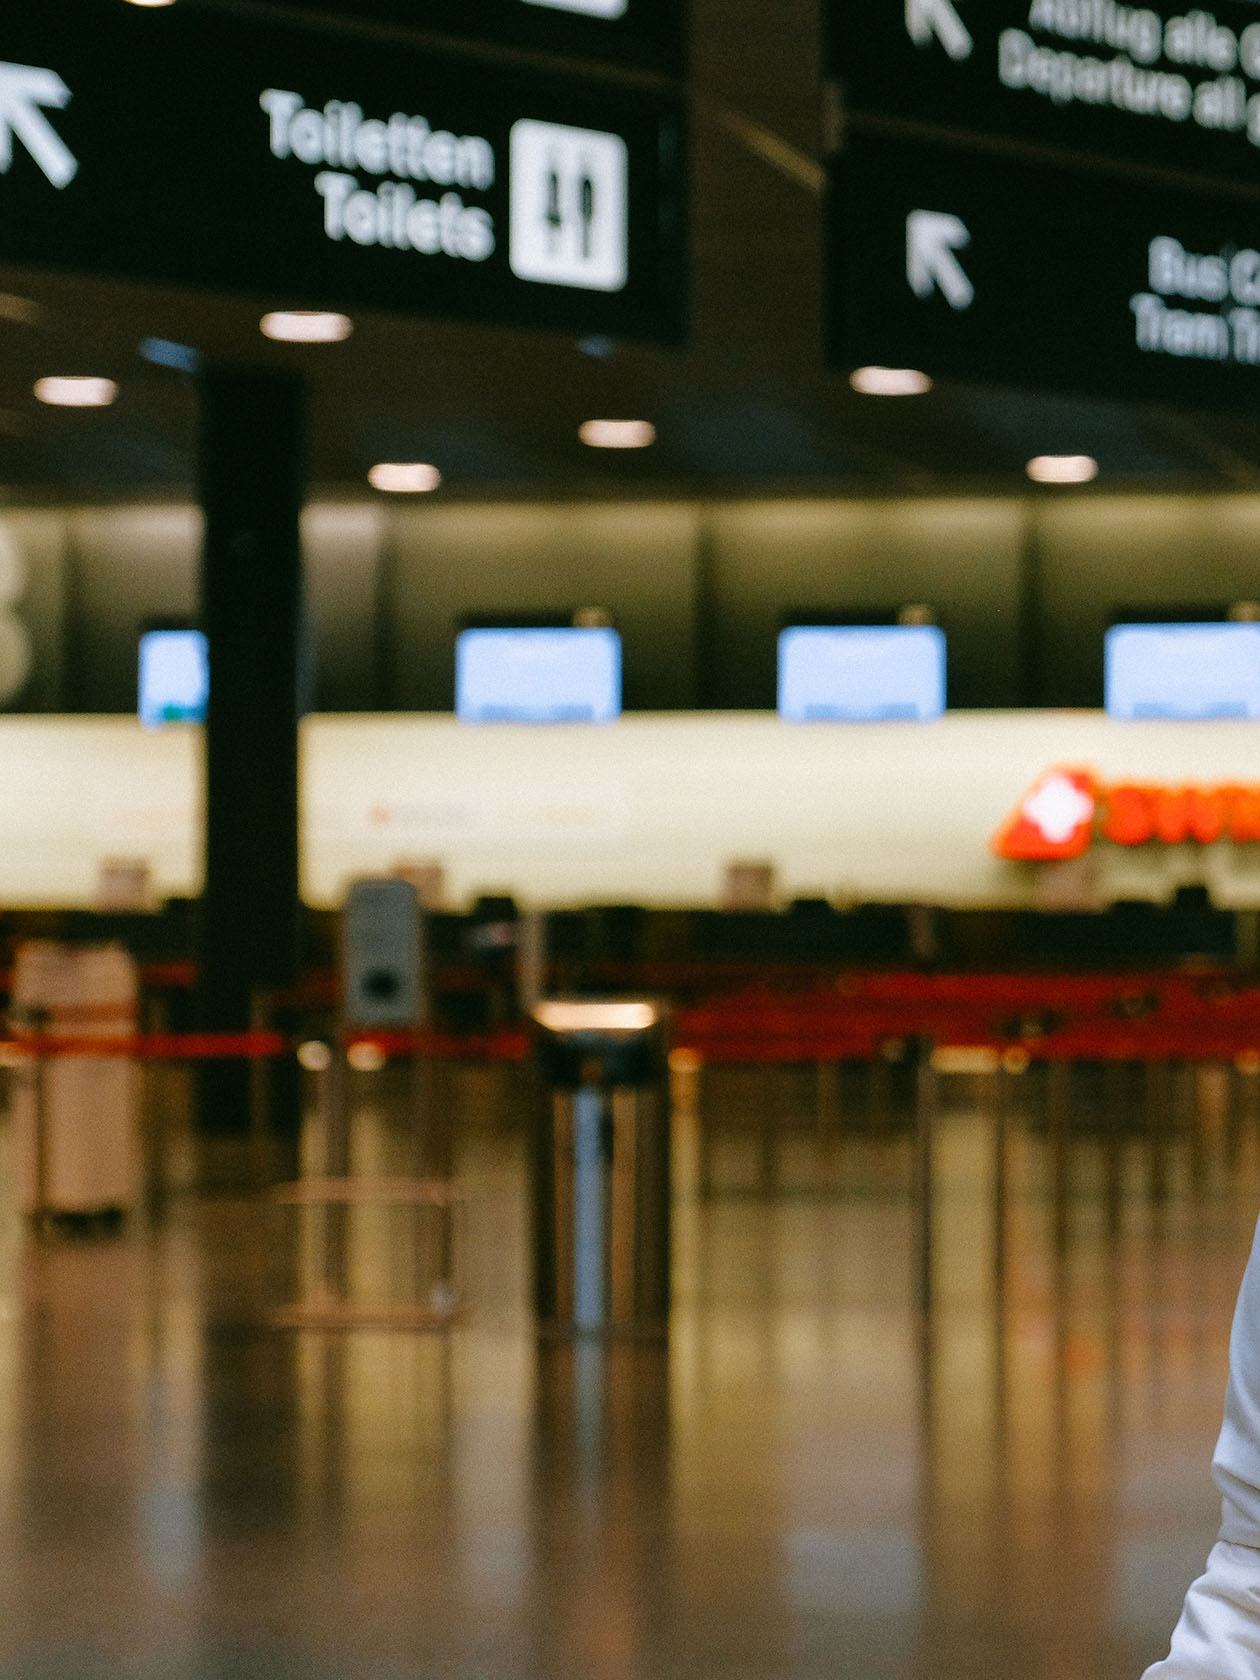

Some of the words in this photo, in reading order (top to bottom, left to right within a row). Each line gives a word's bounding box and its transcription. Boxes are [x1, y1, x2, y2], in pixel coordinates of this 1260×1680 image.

[999, 28, 1192, 122] Departure
[1192, 75, 1246, 131] all
[259, 87, 495, 191] Toiletten
[314, 170, 496, 262] Toilets
[1148, 235, 1229, 302] Bus
[1129, 292, 1229, 361] Tram
